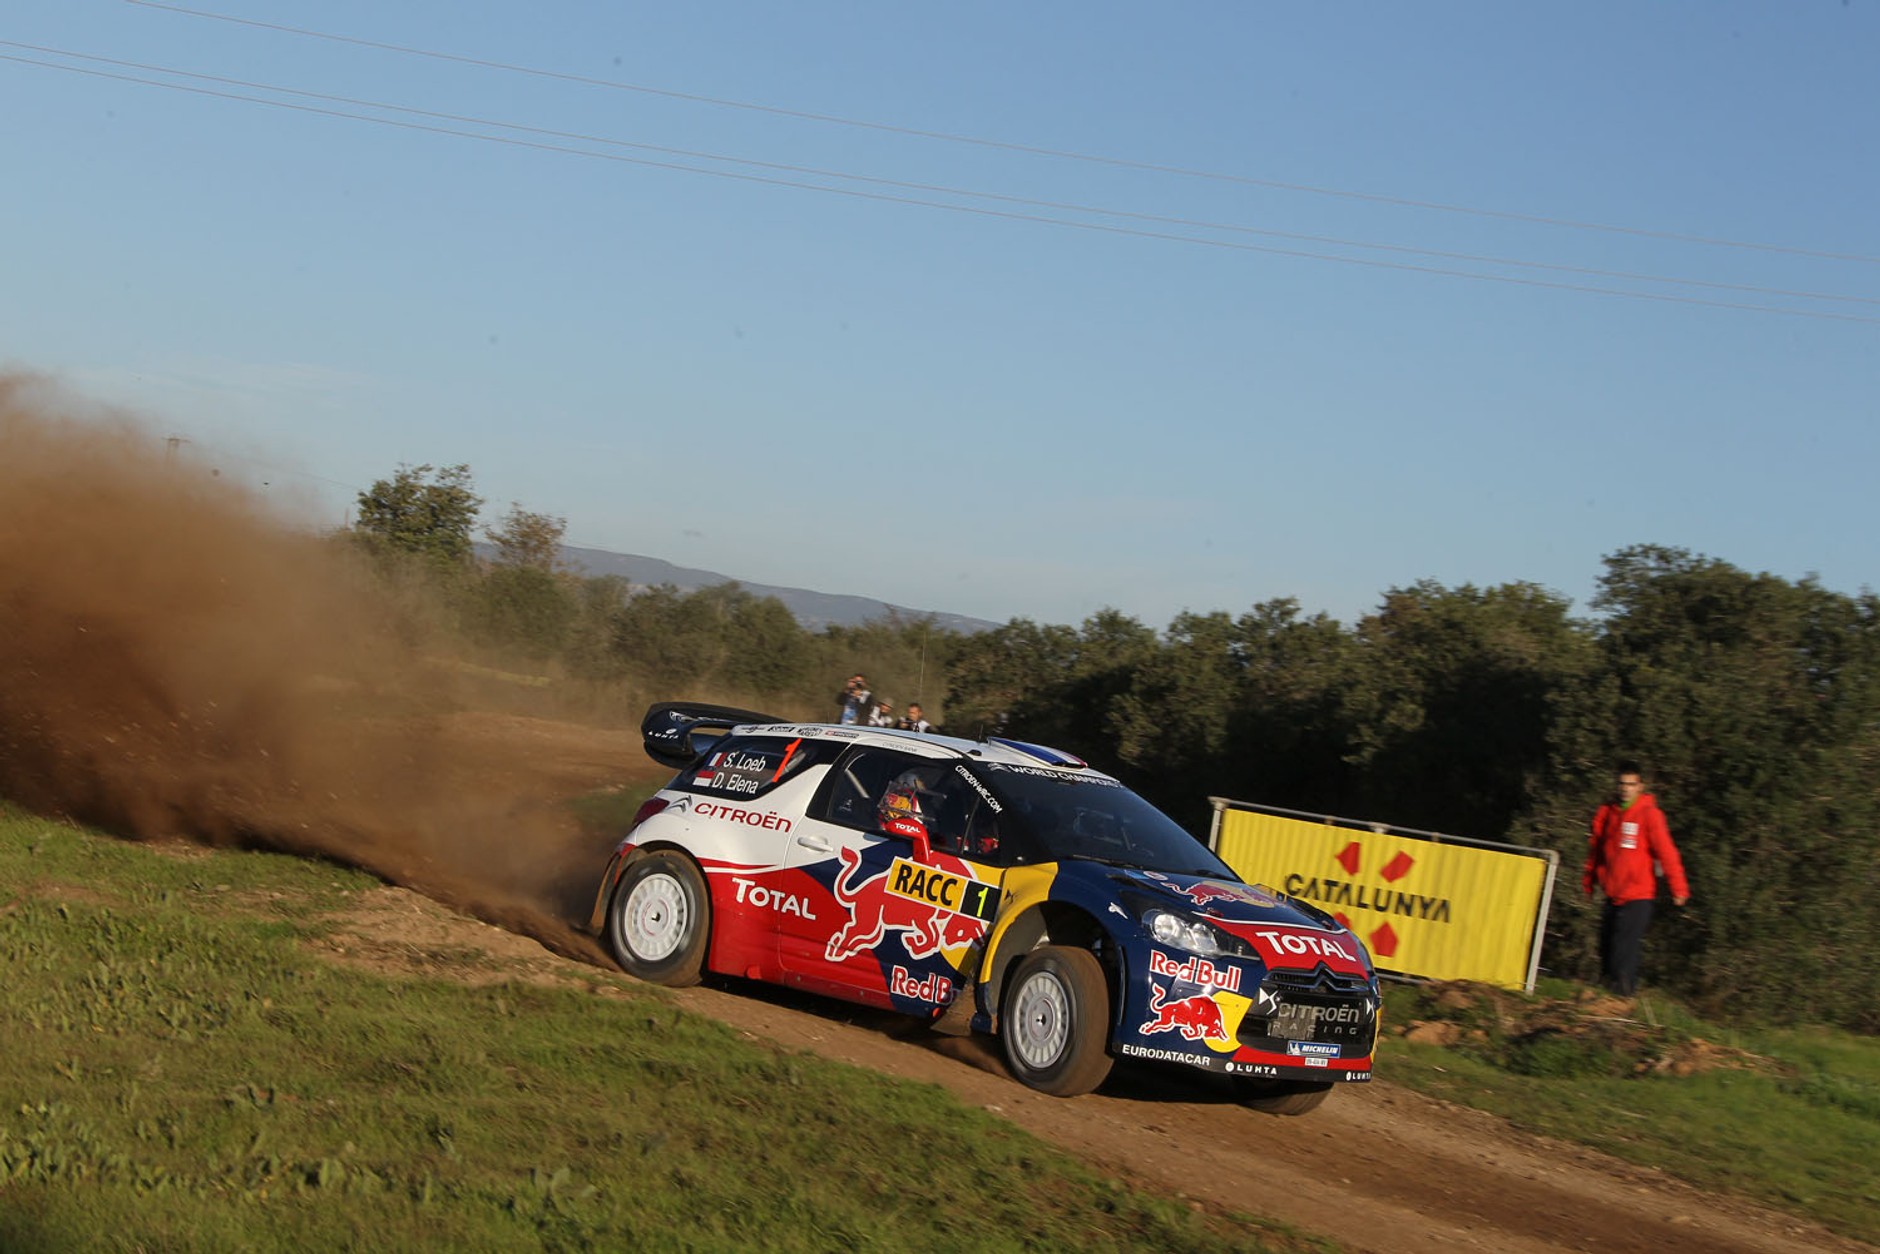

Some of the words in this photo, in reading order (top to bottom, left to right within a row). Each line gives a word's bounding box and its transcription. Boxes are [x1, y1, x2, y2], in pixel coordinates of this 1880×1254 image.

[723, 751, 740, 768] S.
[736, 753, 766, 772] Loeb
[772, 738, 803, 782] 1
[1008, 764, 1058, 779] WORLD
[711, 772, 725, 789] D.
[726, 774, 759, 794] Elena
[894, 822, 921, 833] TOTAL
[732, 876, 816, 921] TOTAL
[894, 863, 958, 907] RACC
[1285, 873, 1451, 923] CATALUNYA
[975, 886, 990, 918] 1
[1255, 931, 1357, 962] TOTAL
[891, 965, 934, 1001] Red
[1150, 949, 1196, 982] Red
[1195, 959, 1242, 992] Bull
[1122, 1044, 1211, 1067] EURODATACAR
[1301, 1044, 1339, 1055] MICHELIN
[1237, 1064, 1278, 1075] LUHTA
